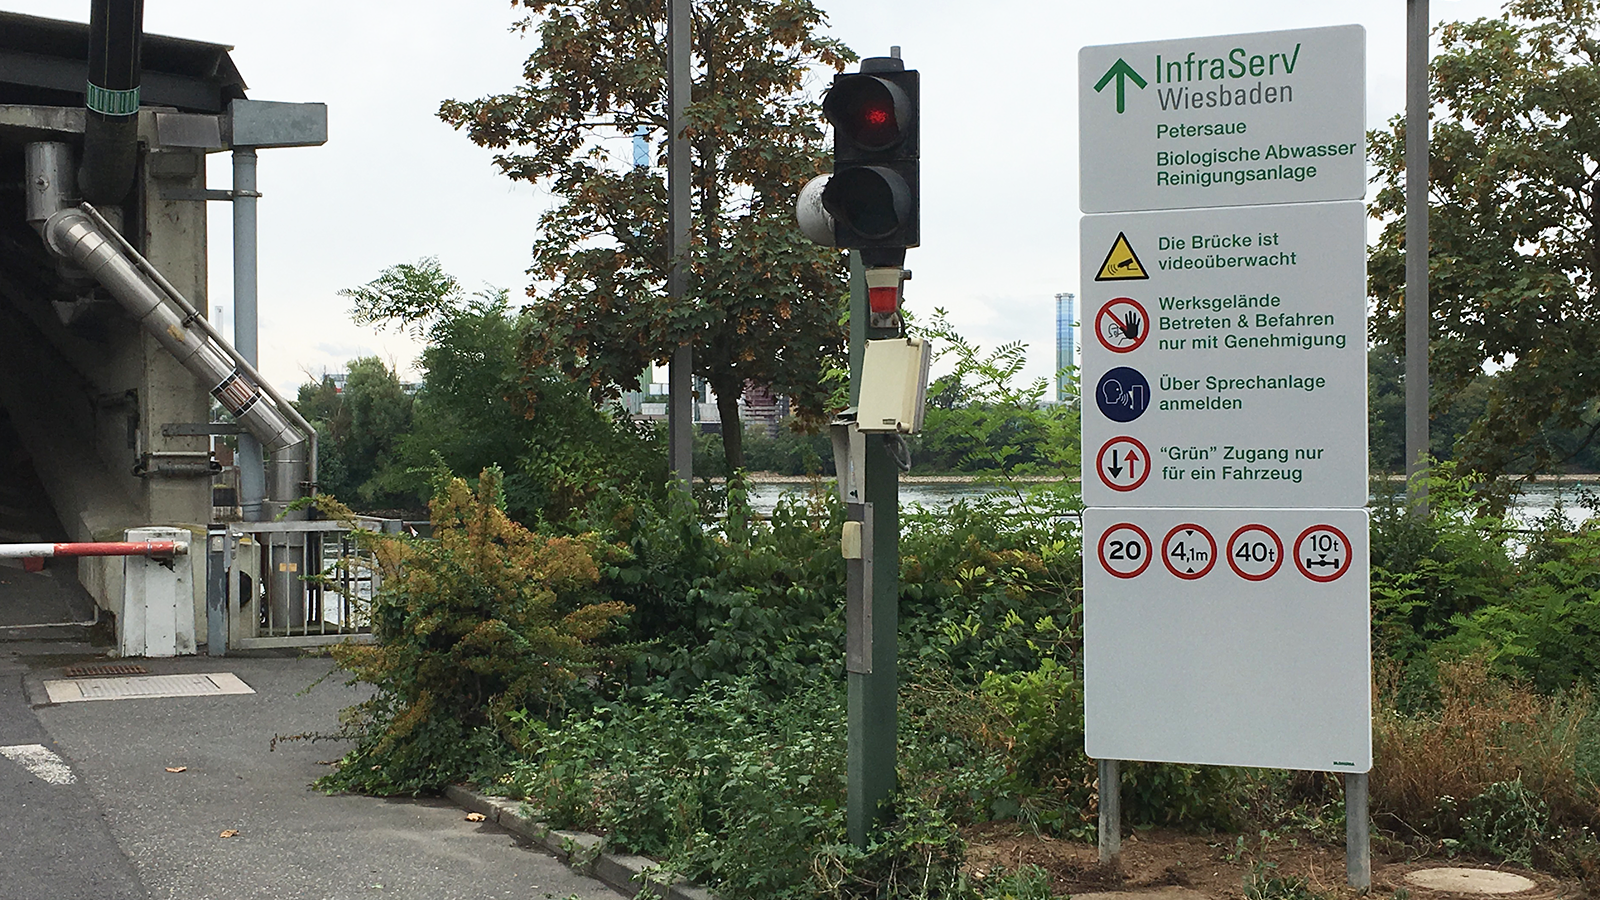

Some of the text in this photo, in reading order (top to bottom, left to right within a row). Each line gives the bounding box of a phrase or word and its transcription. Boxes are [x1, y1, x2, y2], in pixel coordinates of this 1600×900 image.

[1156, 43, 1301, 83] InfraServ
[1158, 82, 1293, 111] Wiesbaden
[1157, 122, 1247, 139] Petersaue
[1157, 143, 1357, 167] Biologische Abwasser
[1157, 165, 1317, 187] Reinigungsanlage
[1159, 233, 1279, 251] Die Brücke ist
[1158, 252, 1297, 270] videoüberwacht
[1159, 294, 1281, 312] Werksgelände
[1160, 313, 1334, 330] Betreten & Befahren
[1159, 333, 1347, 350] nur mit Genehmigung
[1160, 374, 1326, 393] Über Sprechanlage
[1160, 396, 1242, 410] anmelden
[1223, 446, 1288, 462] Zugang
[1295, 447, 1324, 459] nur
[1162, 466, 1303, 483] für ein Fahrzeug
[1109, 540, 1141, 560] 20
[1235, 542, 1275, 562] 40t
[1310, 535, 1339, 553] 10t
